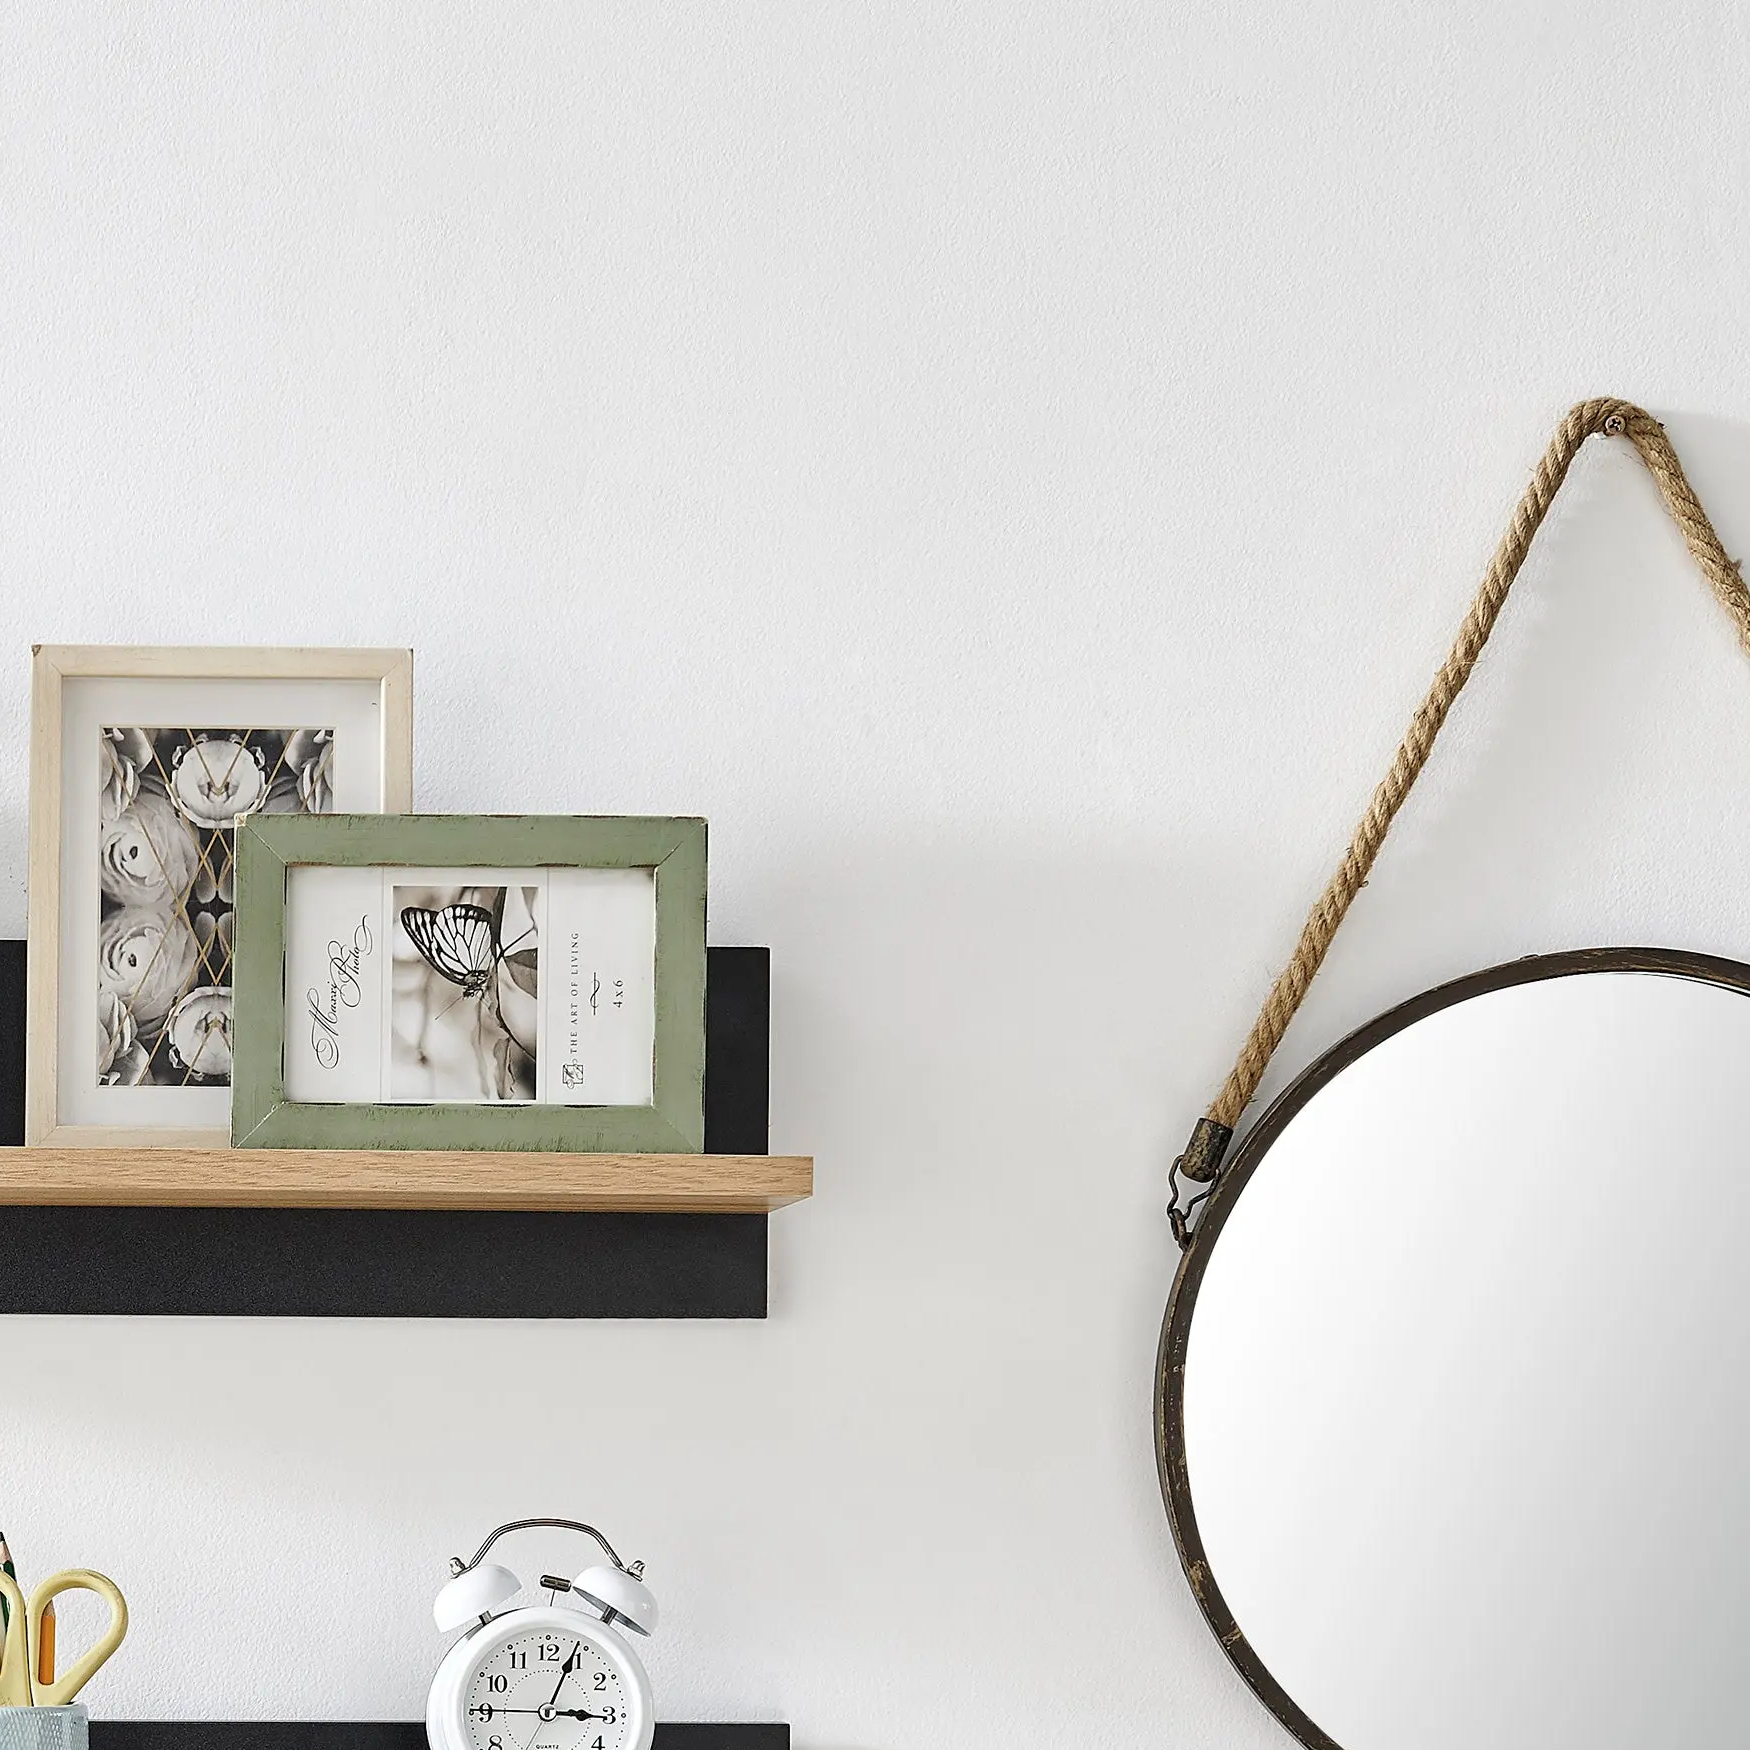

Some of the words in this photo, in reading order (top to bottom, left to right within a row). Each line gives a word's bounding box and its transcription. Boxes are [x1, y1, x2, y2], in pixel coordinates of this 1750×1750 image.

[327, 914, 373, 1008] Photo
[570, 932, 579, 975] LIVING
[570, 982, 579, 997] OF
[570, 1002, 579, 1025] ART
[570, 1031, 578, 1054] THE
[509, 1651, 527, 1670] 11
[538, 1643, 560, 1662] 12
[575, 1652, 583, 1670] 1
[486, 1674, 508, 1693] 10
[593, 1672, 607, 1691] 2
[479, 1702, 493, 1723] 9
[602, 1706, 616, 1724] 3
